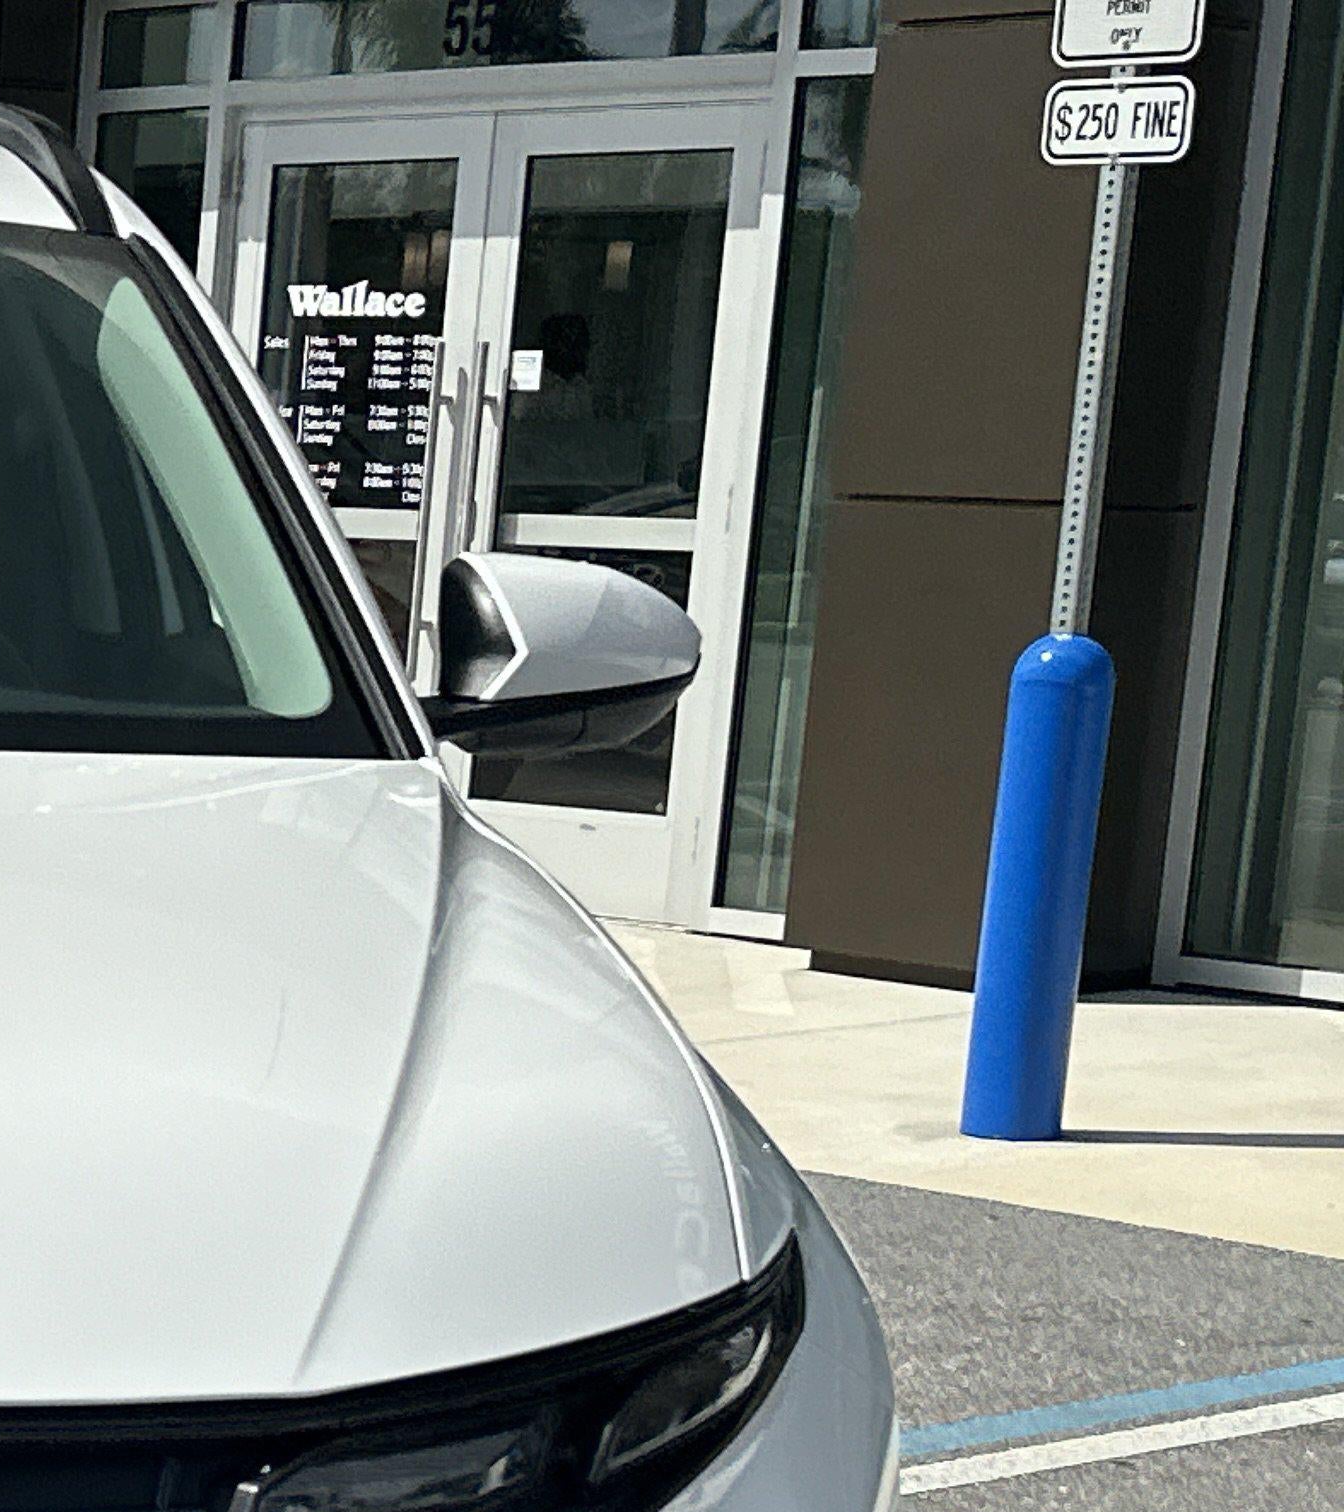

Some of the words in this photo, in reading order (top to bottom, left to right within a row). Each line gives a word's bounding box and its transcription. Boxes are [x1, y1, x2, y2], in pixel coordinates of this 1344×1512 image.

[1055, 101, 1119, 145] $250
[1130, 101, 1181, 139] FINE
[287, 280, 426, 317] Wallace
